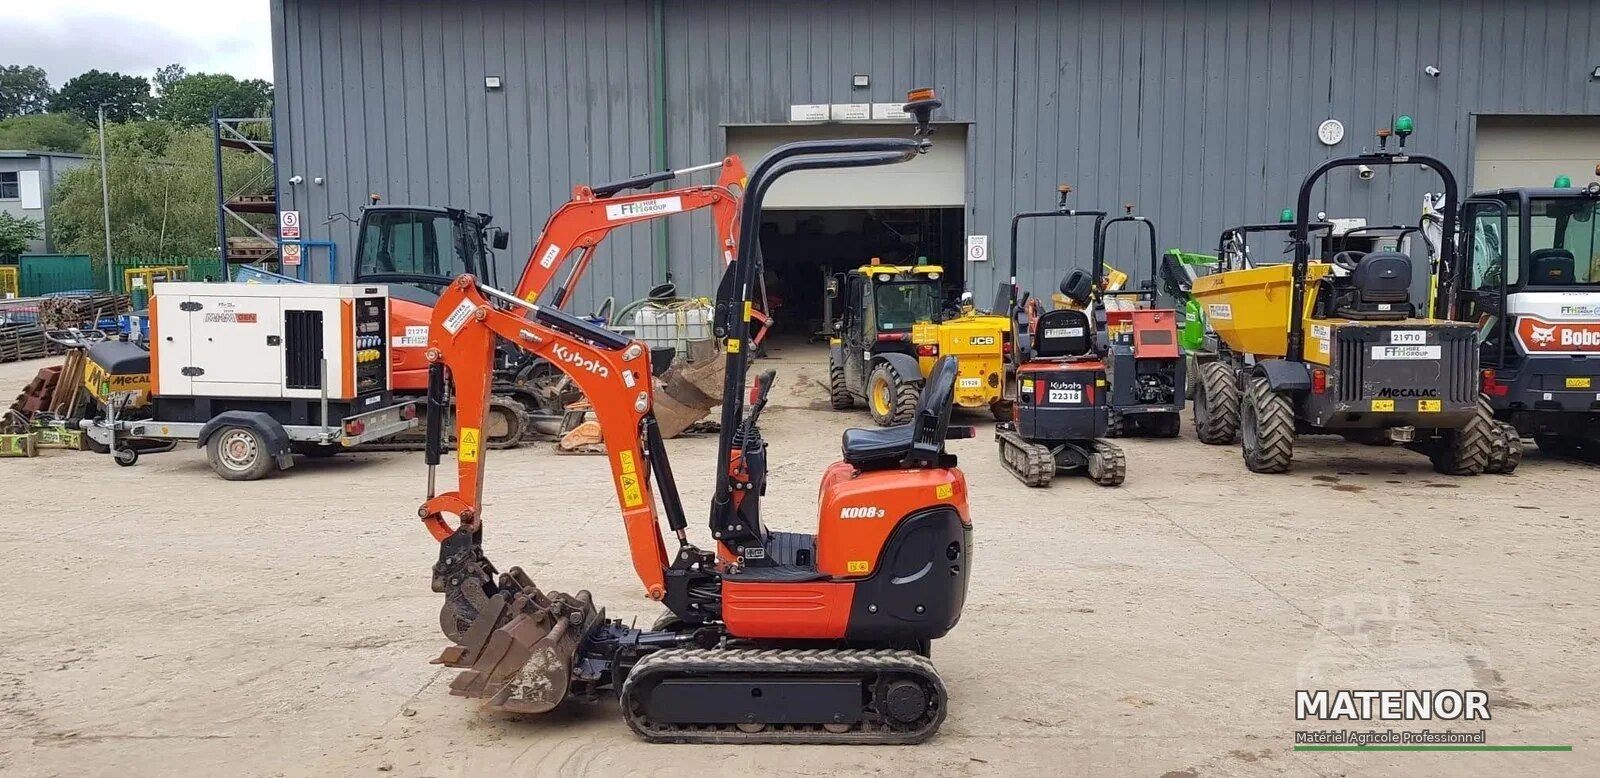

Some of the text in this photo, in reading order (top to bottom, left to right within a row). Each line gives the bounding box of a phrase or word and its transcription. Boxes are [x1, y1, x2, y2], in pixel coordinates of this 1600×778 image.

[621, 202, 643, 215] FTH
[644, 204, 667, 212] GROUP
[287, 216, 293, 224] 5
[970, 337, 994, 345] JCB
[1384, 346, 1405, 357] FTH
[552, 343, 609, 378] Kubota
[1050, 381, 1082, 390] Kubota
[840, 507, 885, 518] K008-3
